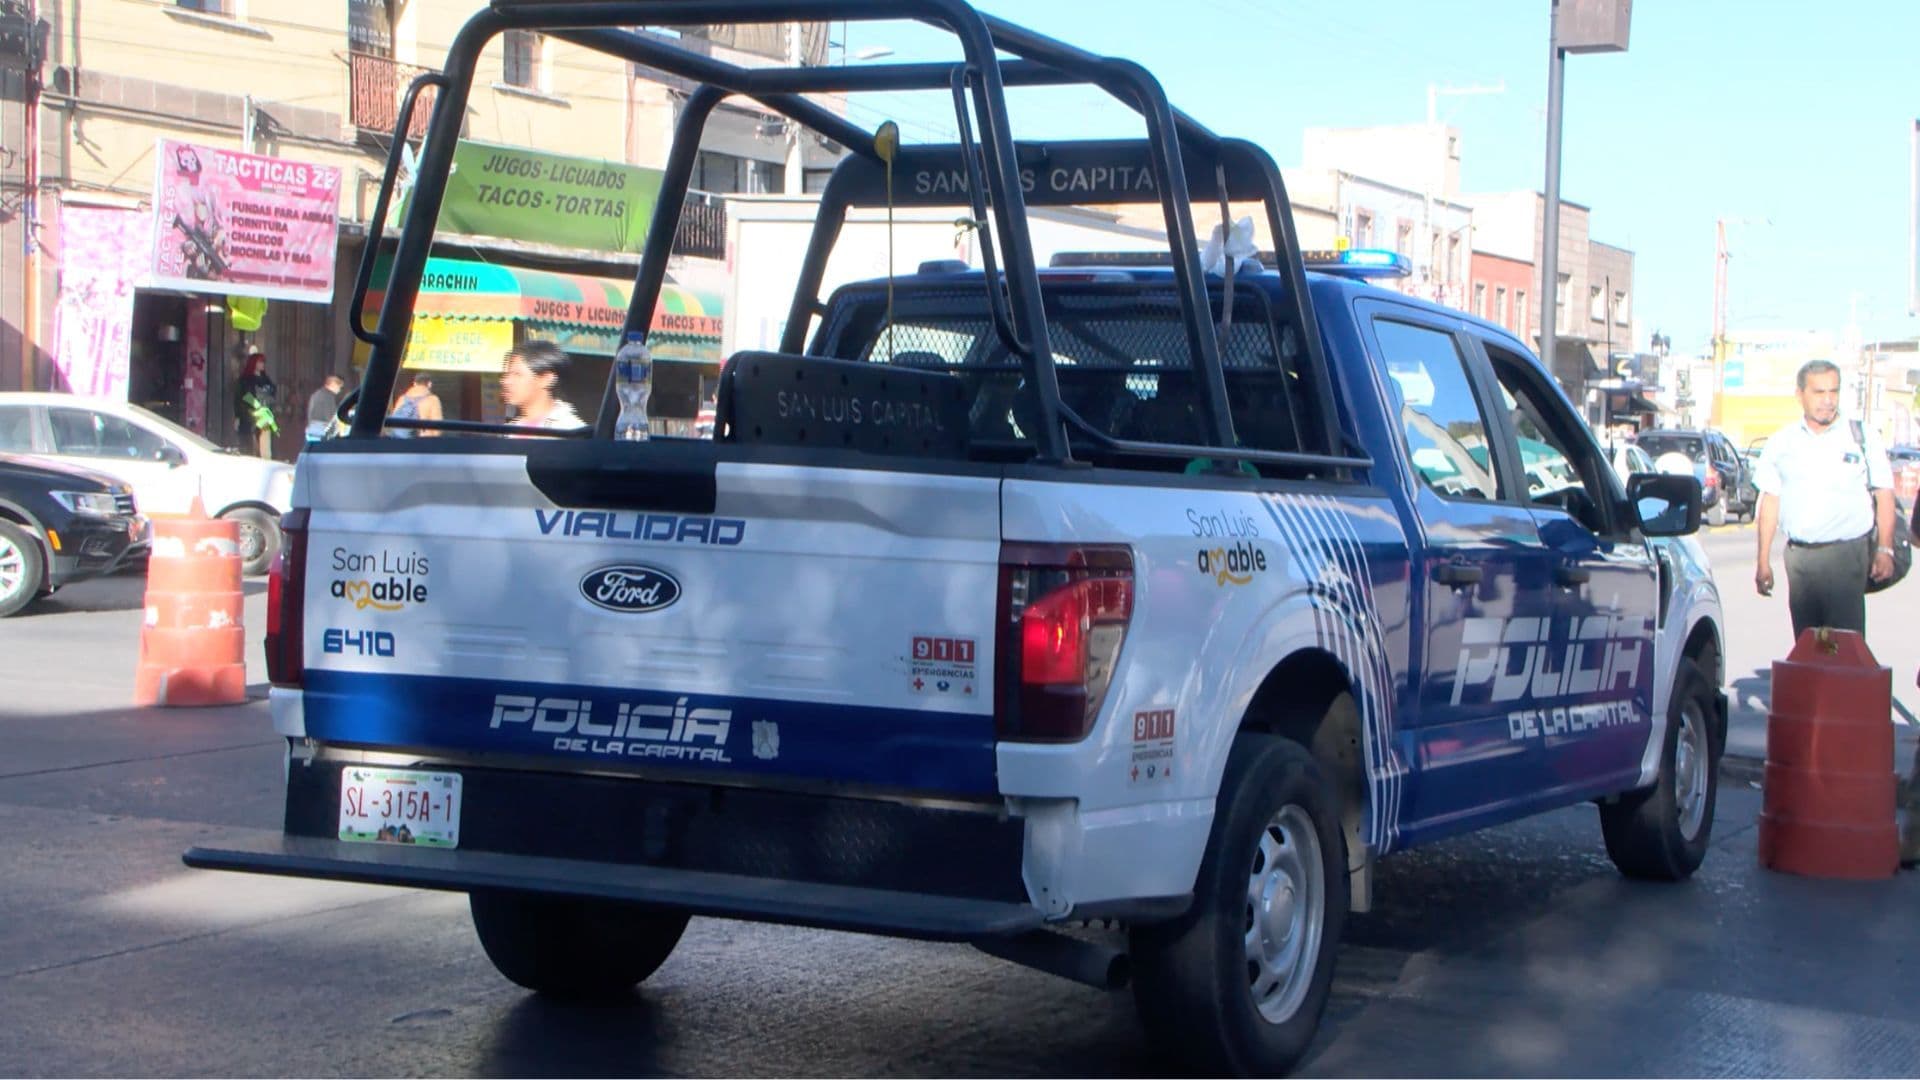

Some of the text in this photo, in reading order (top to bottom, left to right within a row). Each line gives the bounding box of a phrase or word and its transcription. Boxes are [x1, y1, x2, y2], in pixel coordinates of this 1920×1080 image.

[215, 153, 308, 185] TACTICAS
[915, 170, 969, 193] SAN
[1051, 167, 1154, 191] CAPITA
[231, 216, 288, 234] FORNITURA
[232, 201, 272, 217] FUNDAS
[274, 207, 299, 220] PARA
[231, 230, 284, 247] CHALECOS
[230, 245, 281, 262] MOCHILAS
[534, 300, 570, 316] JUGOS
[576, 304, 584, 317] Y
[661, 314, 695, 331] TACOS
[700, 317, 706, 333] Y
[778, 391, 944, 431] SAN LUIS CAPITAL
[535, 509, 746, 546] VIALIDAD
[1186, 508, 1259, 537] San Luis
[332, 546, 429, 576] San Luis
[1198, 541, 1266, 586] amable
[331, 576, 428, 610] amable
[597, 571, 662, 605] Ford
[323, 628, 396, 657] 6410
[915, 638, 973, 662] 911
[1451, 594, 1645, 707] POLICÍA
[489, 694, 733, 745] POLICÍA
[1136, 712, 1173, 739] 911
[1508, 699, 1641, 741] DE LA CAPITAL
[553, 737, 732, 763] DE LA CAPITAL
[346, 786, 452, 822] SL-315A-1
